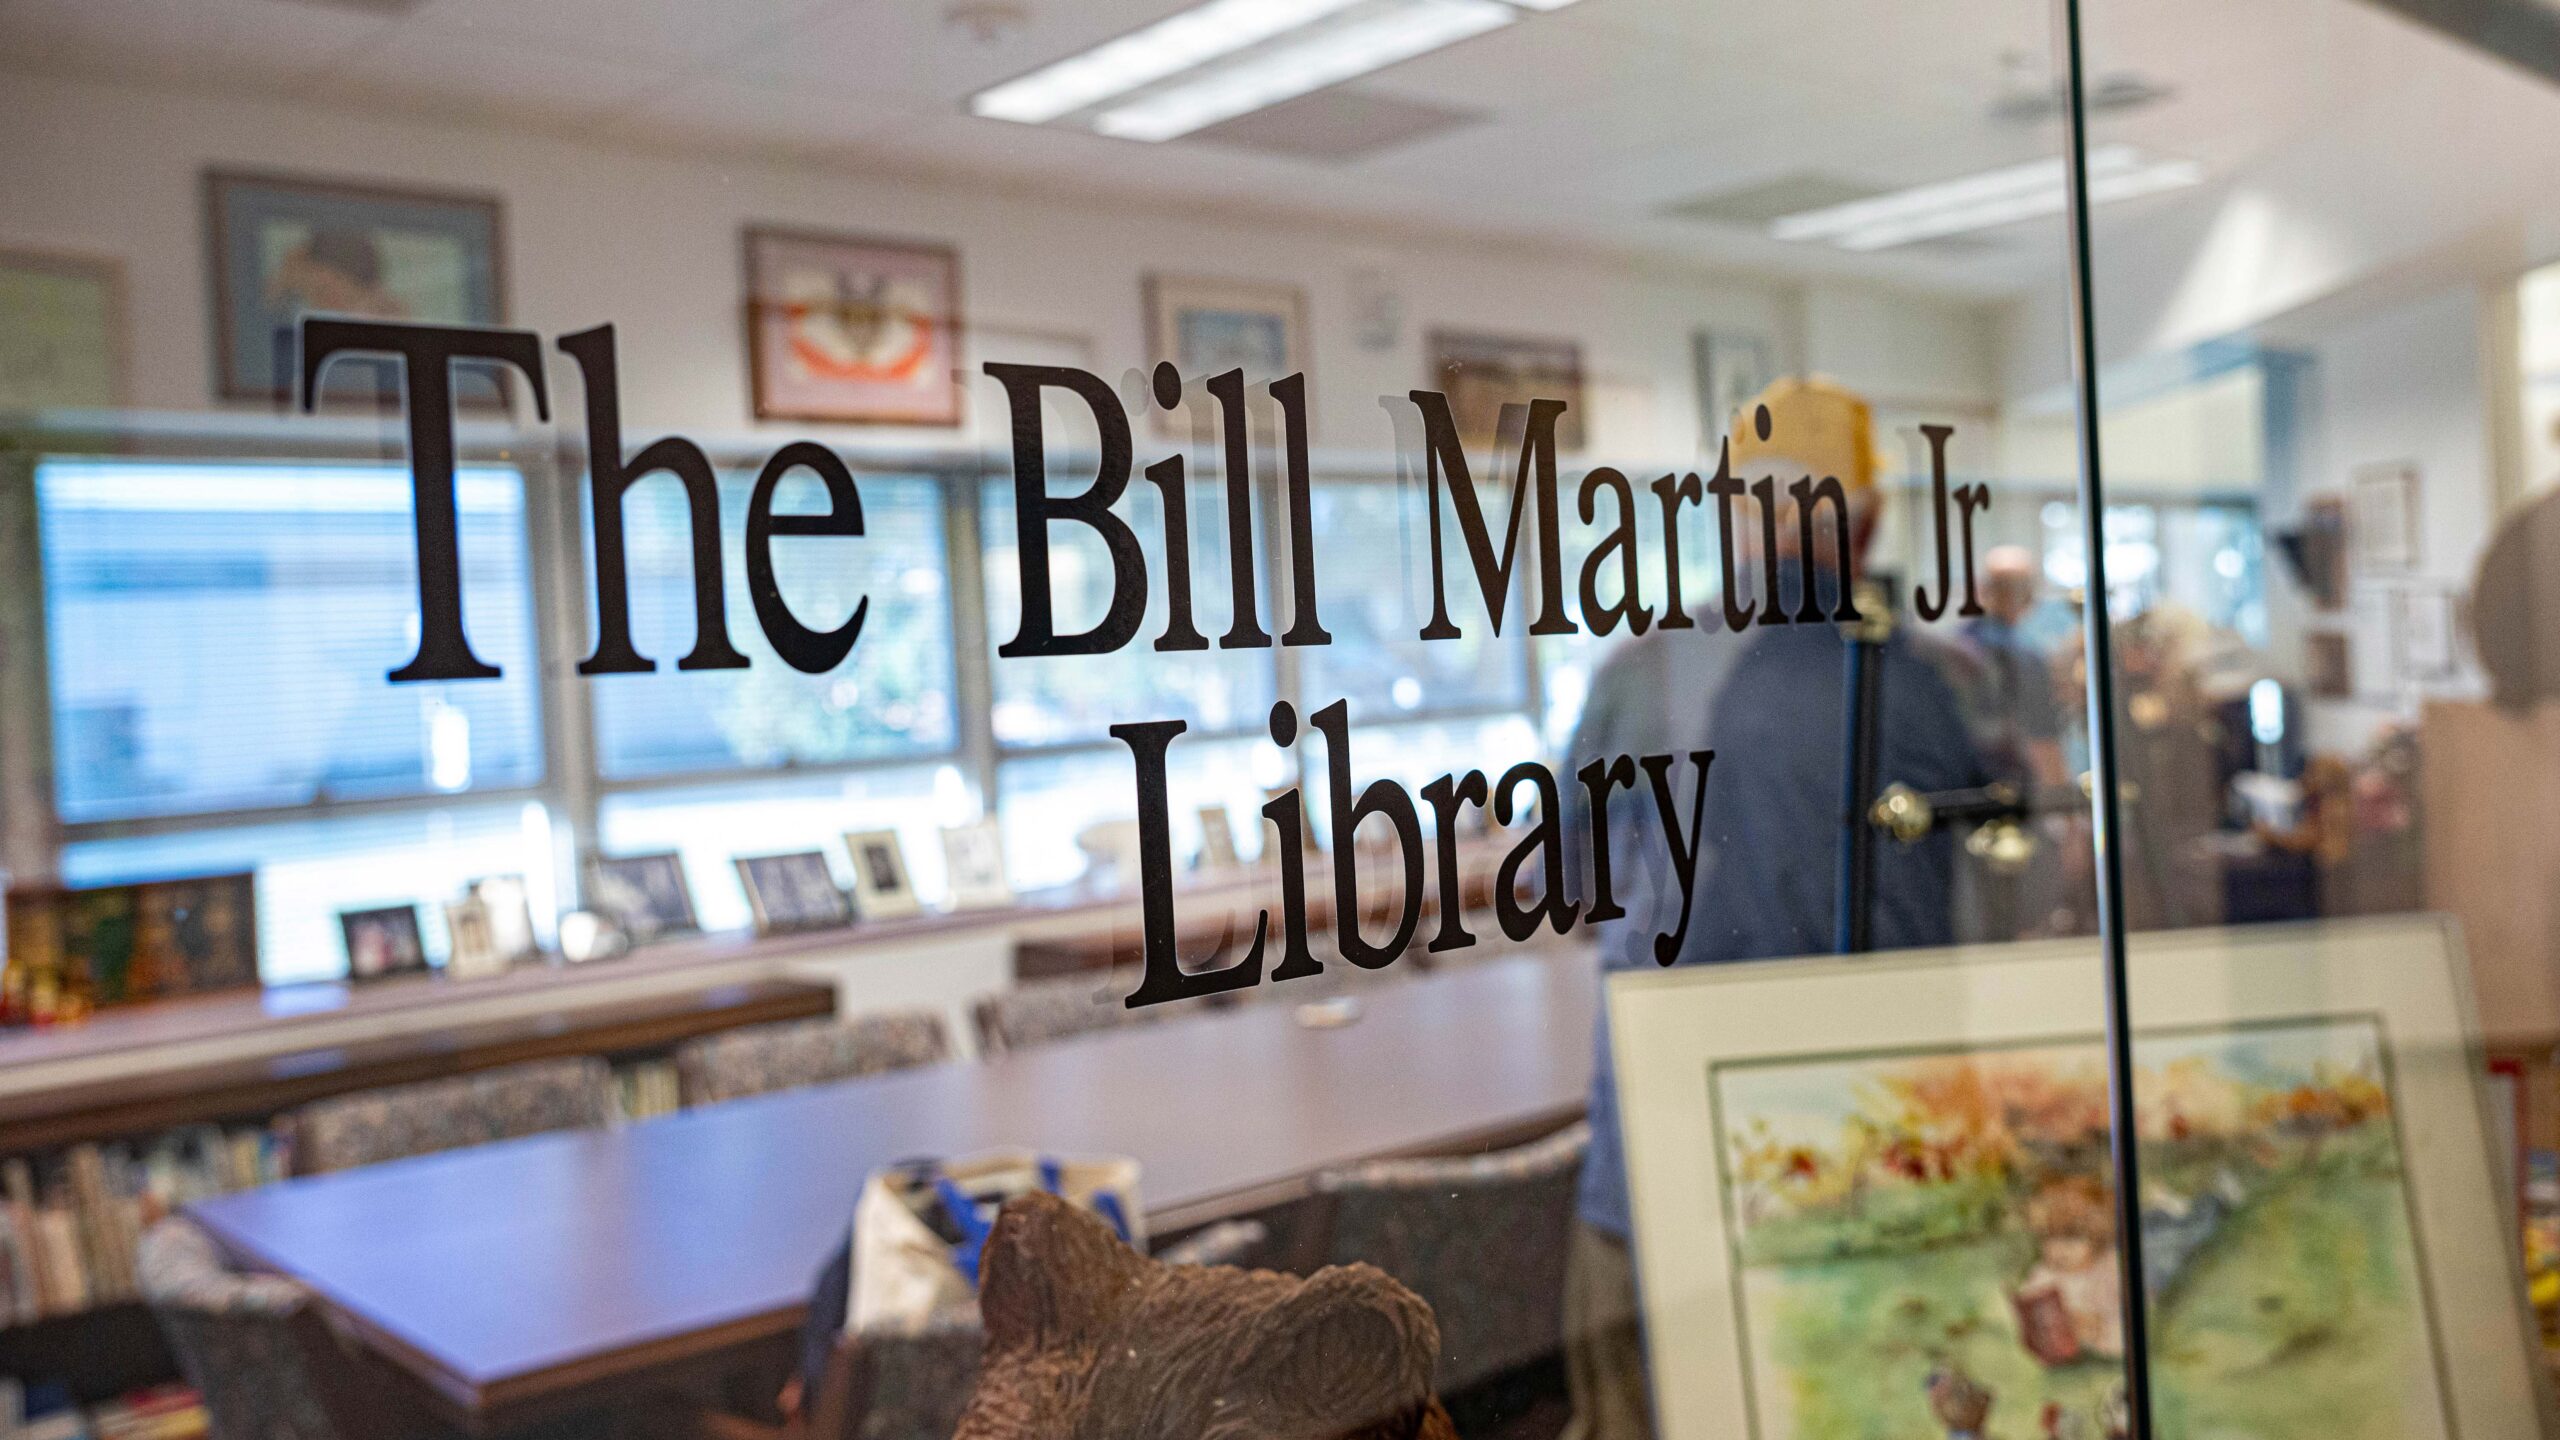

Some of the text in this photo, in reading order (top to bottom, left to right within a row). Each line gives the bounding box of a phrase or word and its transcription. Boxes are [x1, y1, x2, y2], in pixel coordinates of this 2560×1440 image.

[302, 318, 1989, 682] The Bill Martin Jr
[1110, 699, 1716, 1009] Library
